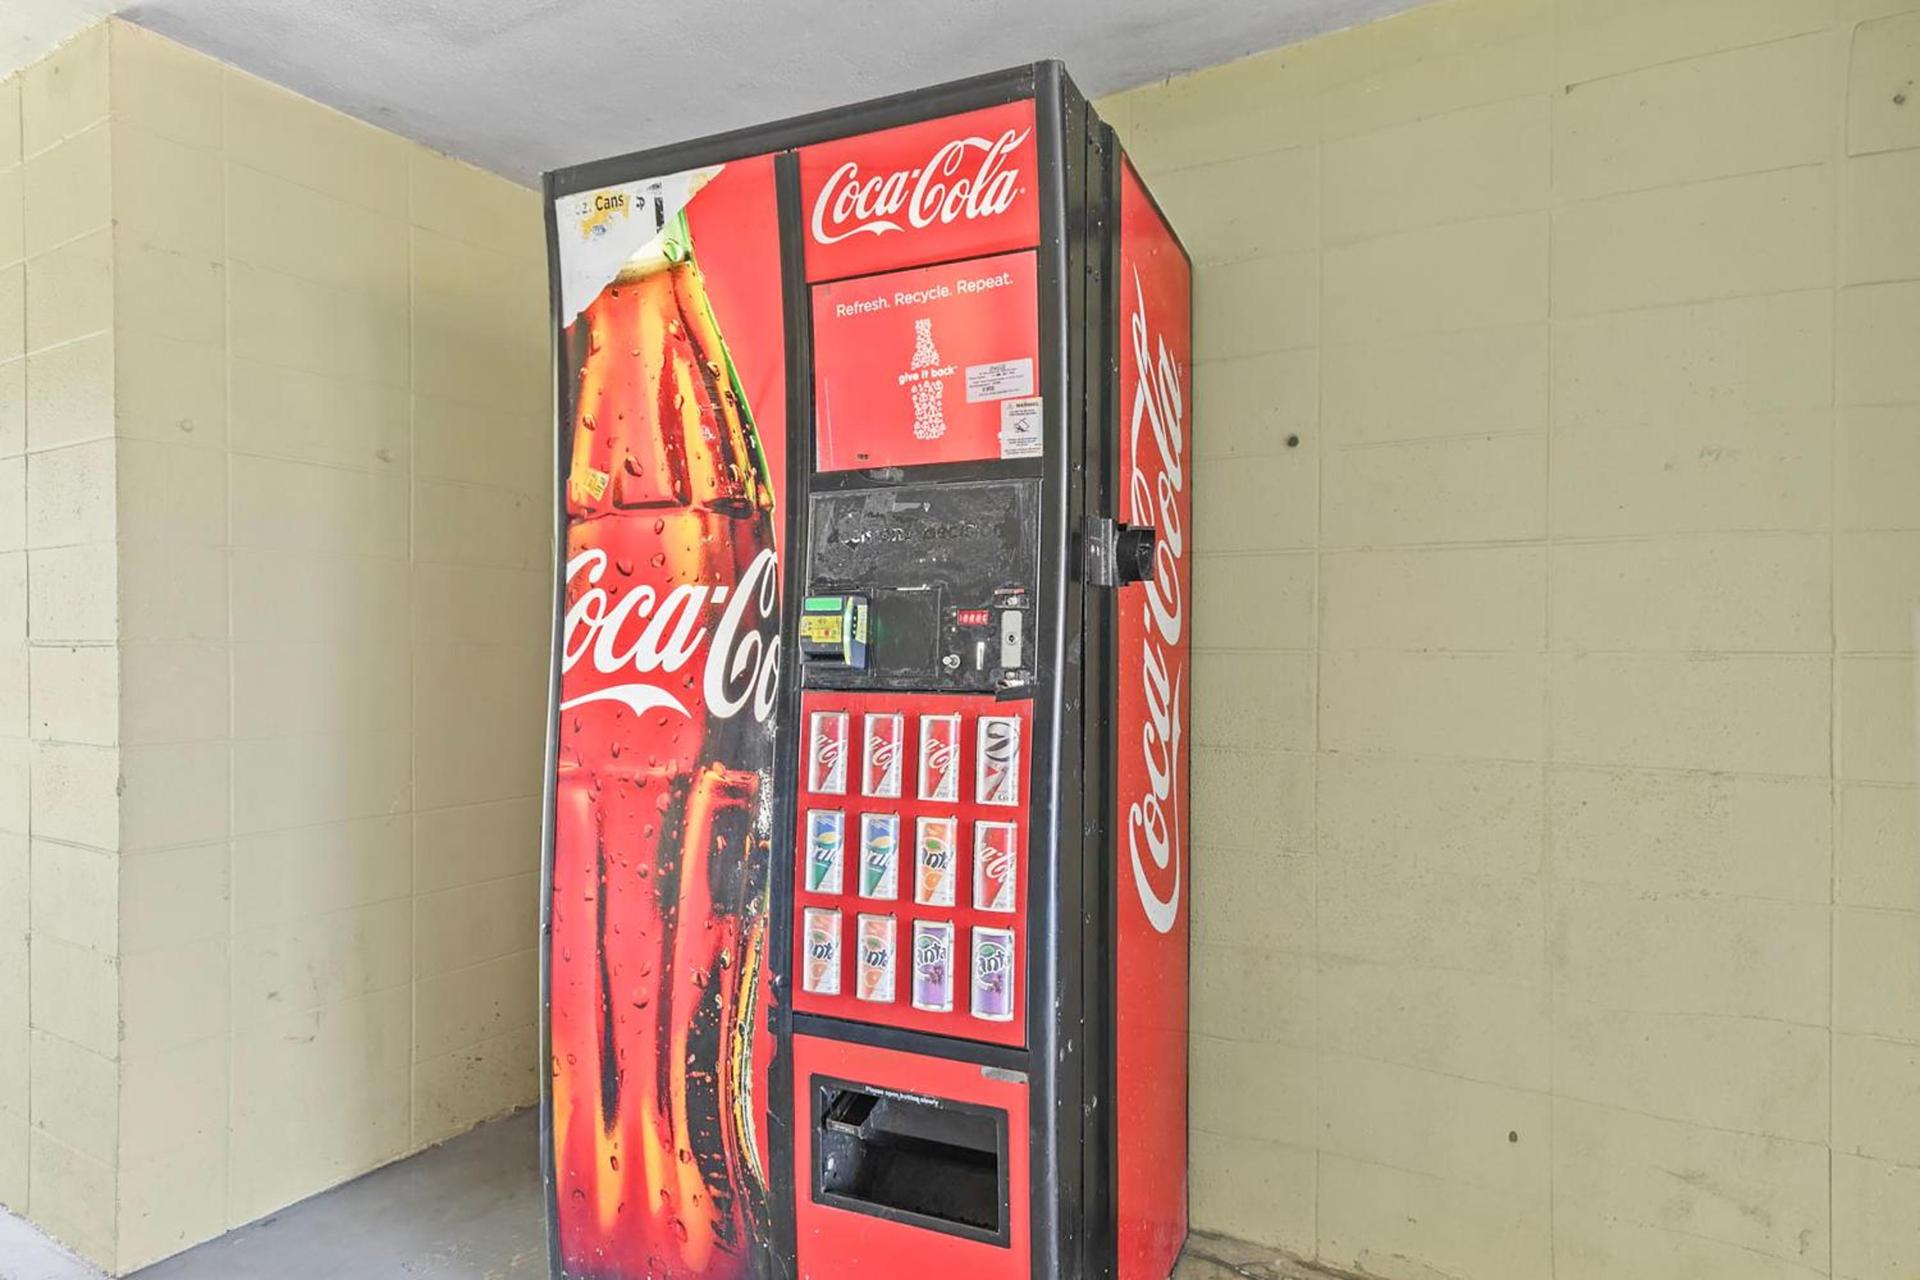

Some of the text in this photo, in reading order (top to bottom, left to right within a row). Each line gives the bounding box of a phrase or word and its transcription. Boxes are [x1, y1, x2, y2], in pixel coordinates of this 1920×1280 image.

[595, 194, 624, 211] Cans
[811, 125, 1032, 245] Coca-Cola
[836, 271, 1013, 317] Refresh. Recycle. Repeat.
[898, 366, 955, 385] give it back
[1129, 261, 1185, 934] Coca-Cola
